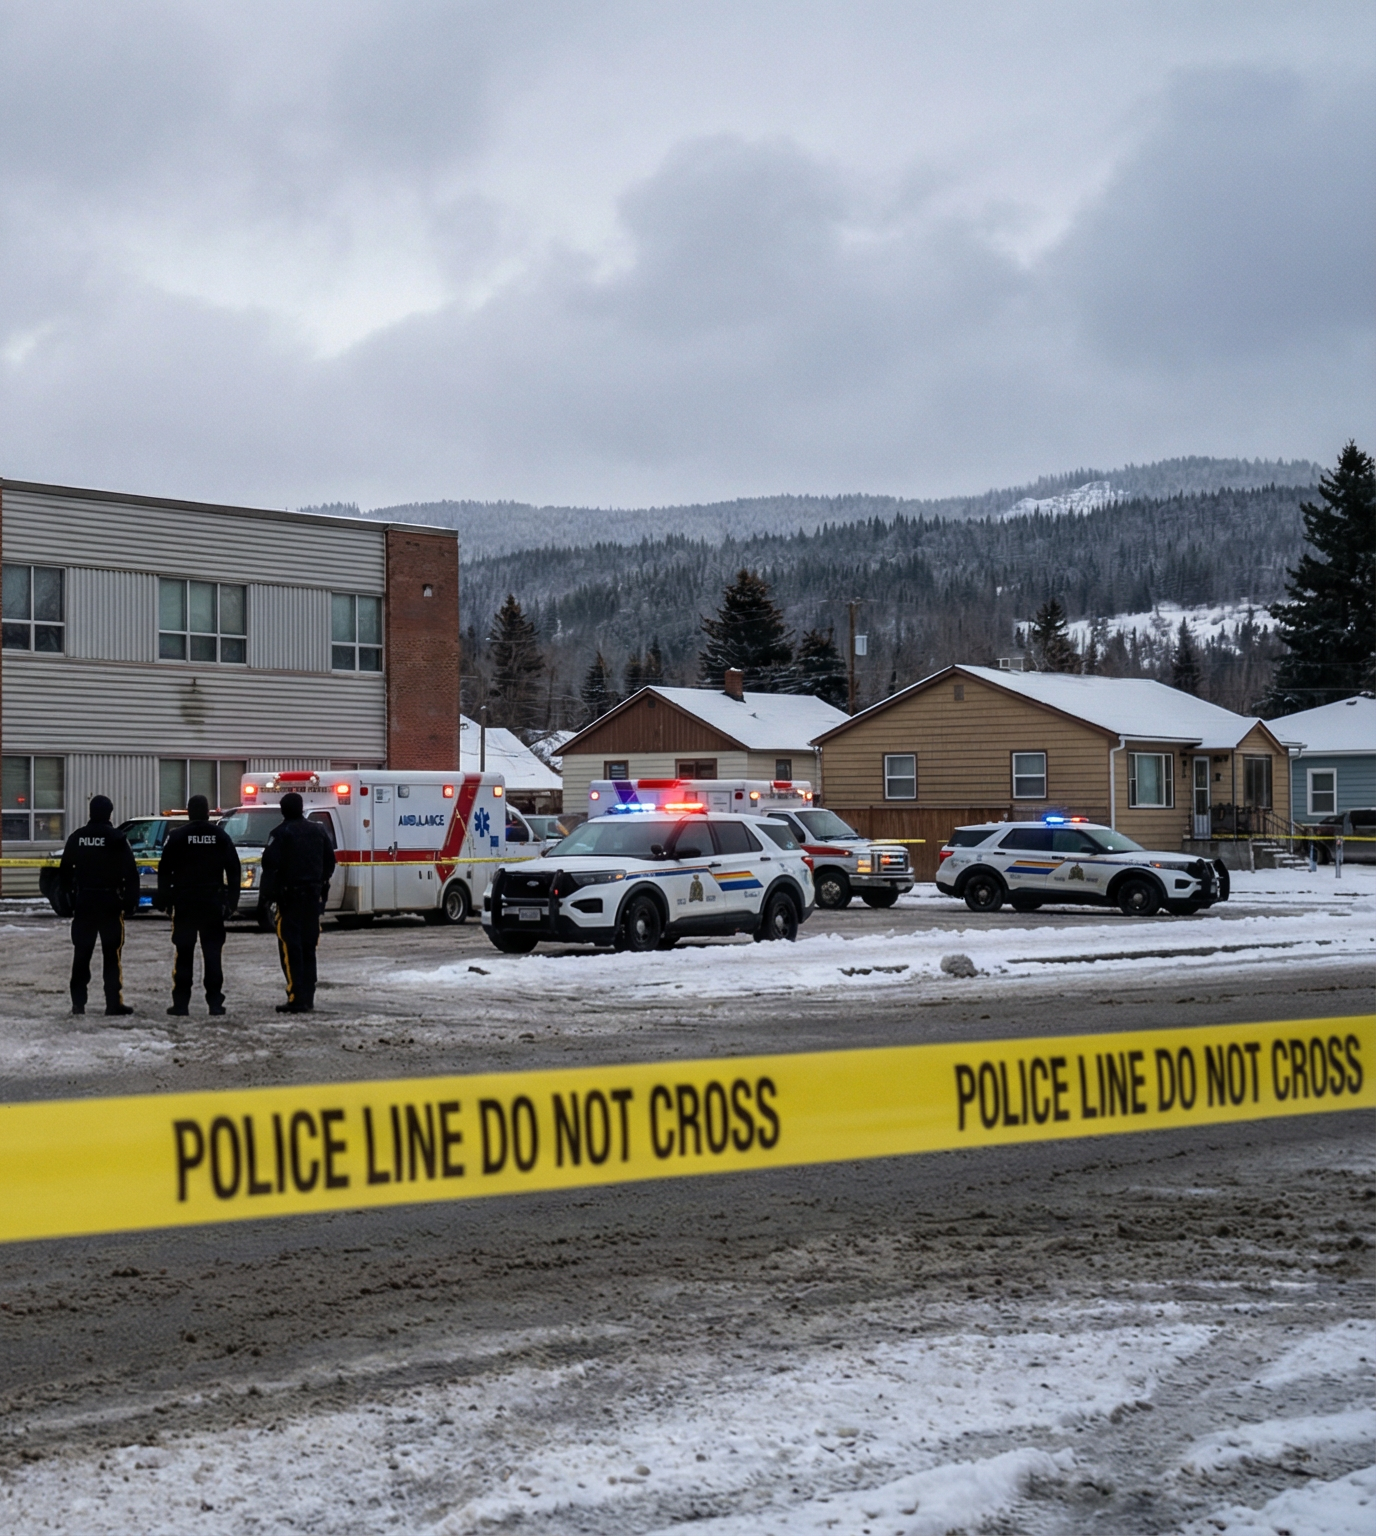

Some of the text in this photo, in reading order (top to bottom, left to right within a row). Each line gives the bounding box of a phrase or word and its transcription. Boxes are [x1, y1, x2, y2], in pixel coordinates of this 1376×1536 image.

[954, 1033, 1365, 1132] POLICE LINE DO NOT CROSS
[173, 1076, 781, 1203] POLICE LINE DO NOT CROSS
